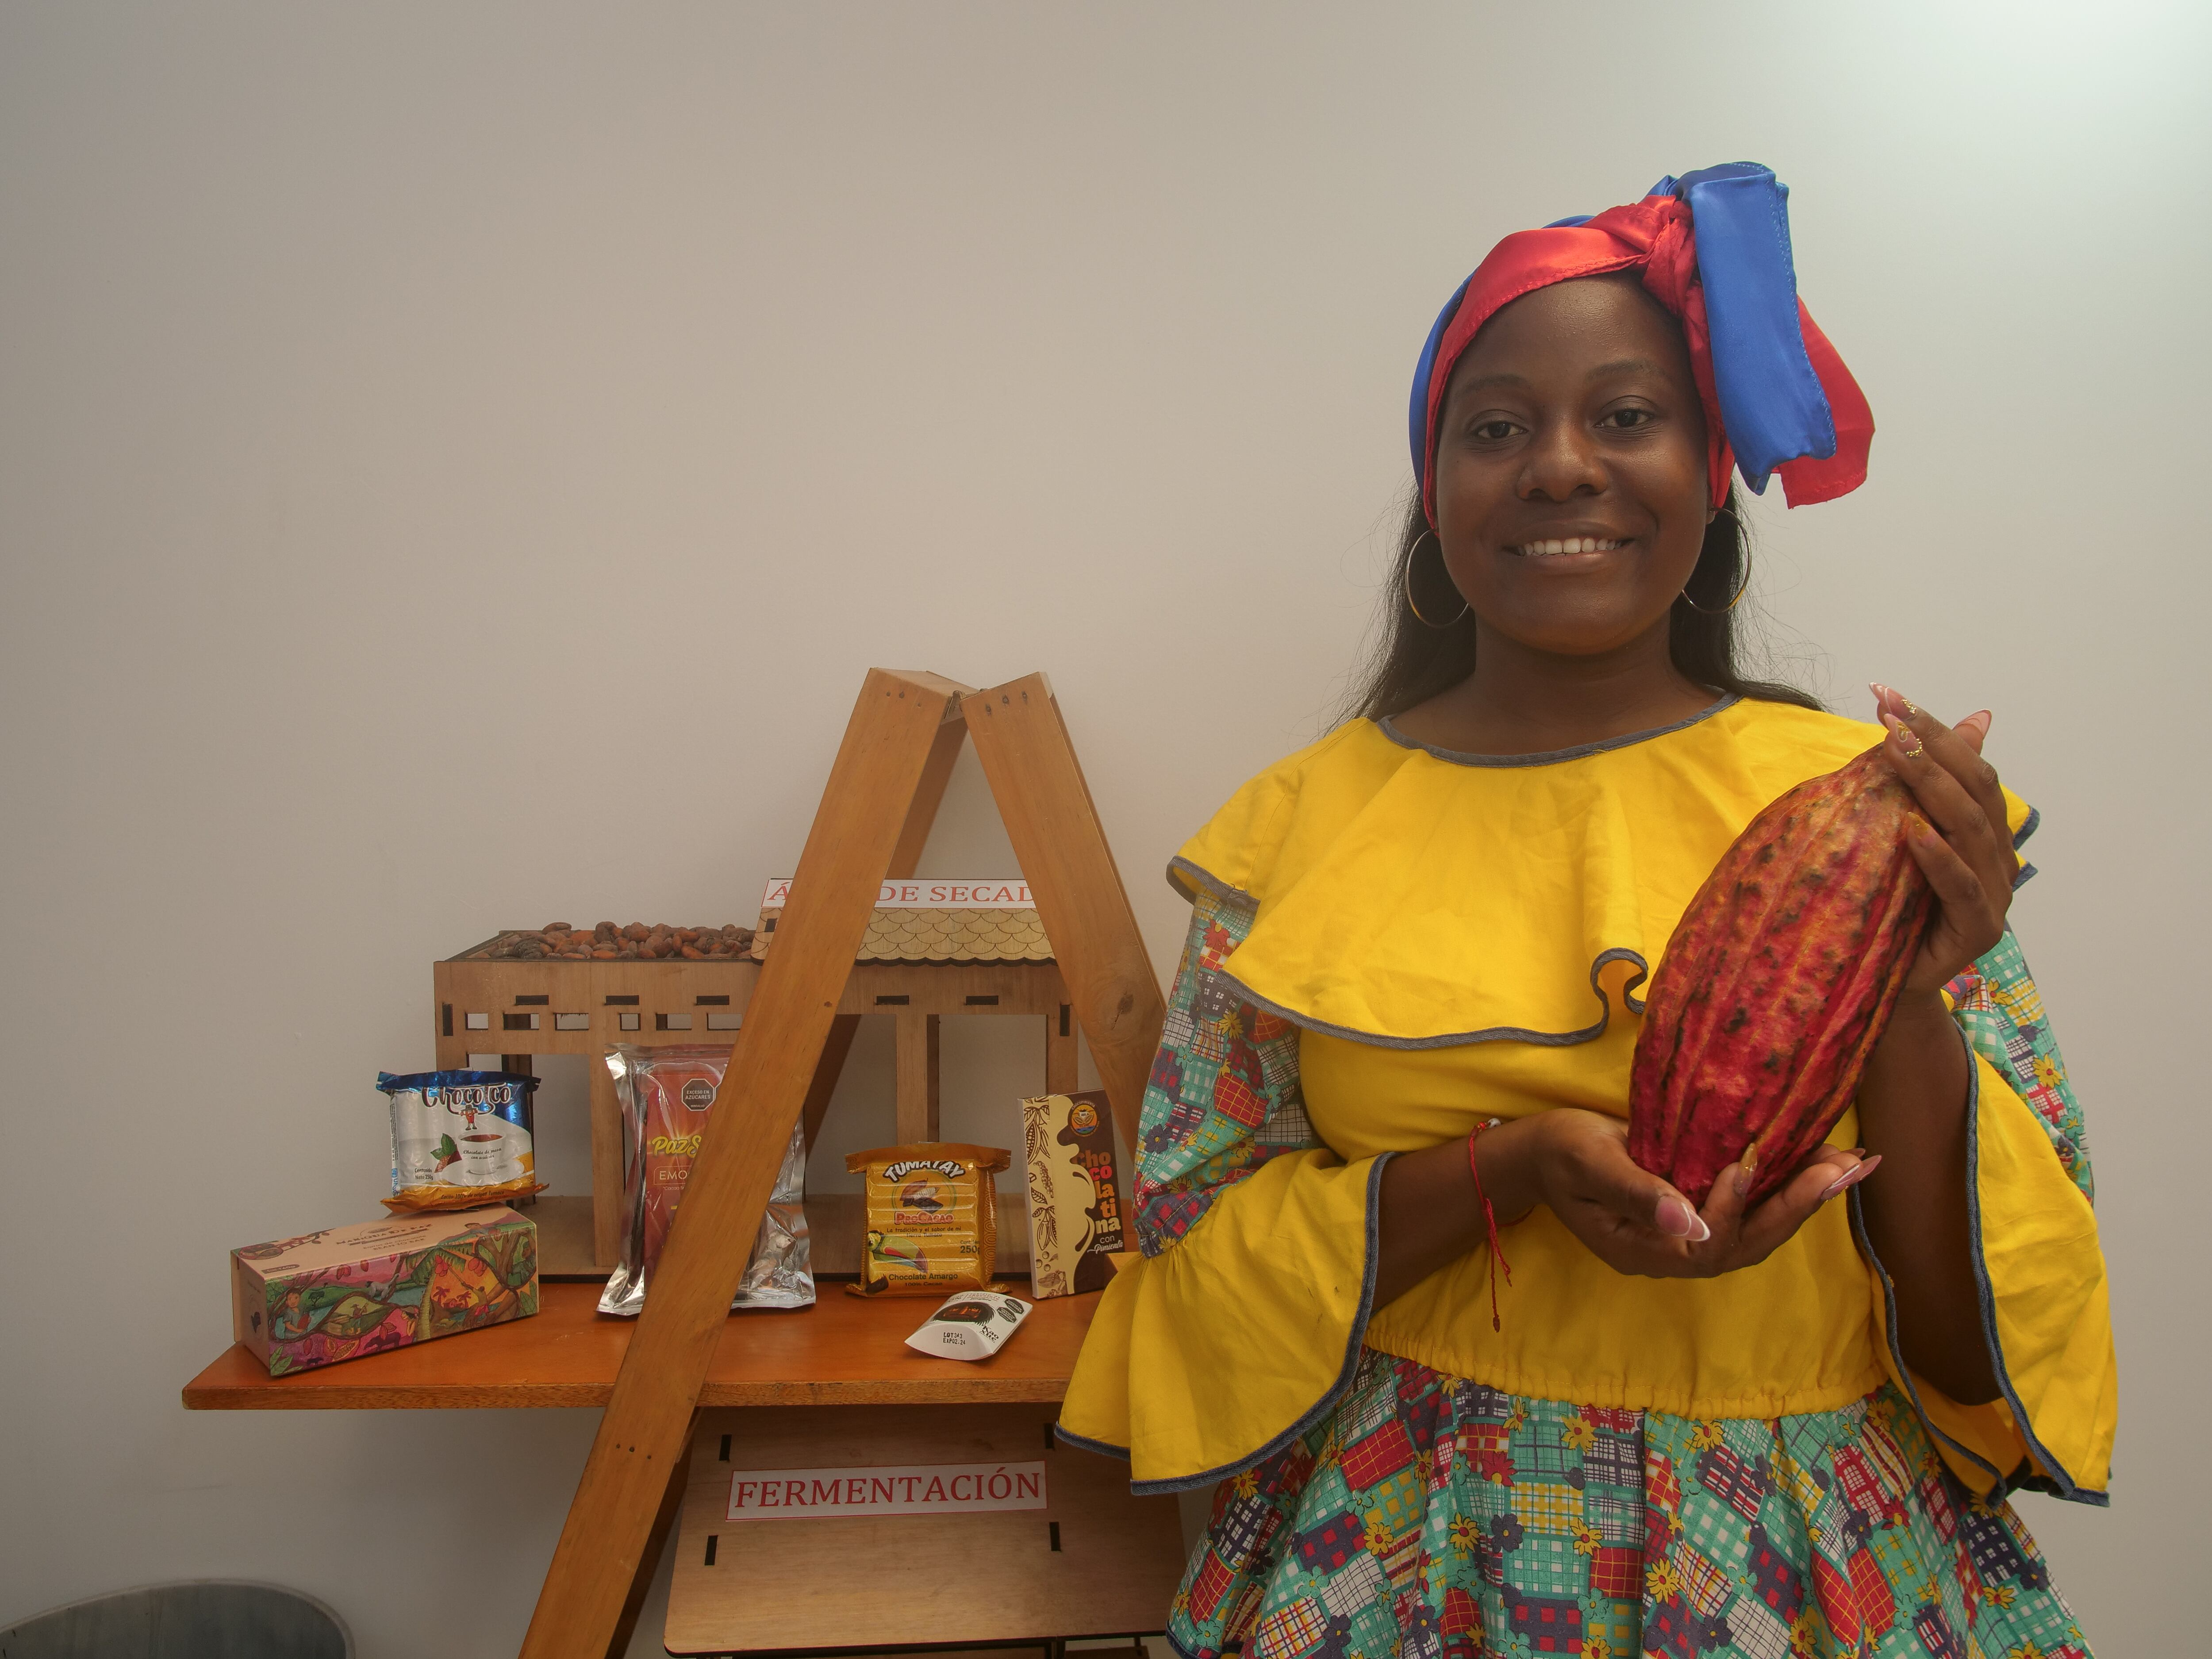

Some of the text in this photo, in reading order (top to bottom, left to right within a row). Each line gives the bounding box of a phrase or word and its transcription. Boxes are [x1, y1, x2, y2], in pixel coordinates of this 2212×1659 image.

[876, 886, 919, 901] DE
[660, 1170, 690, 1180] EMO
[1088, 1165, 1112, 1181] co
[1094, 1180, 1114, 1199] la
[1100, 1198, 1116, 1217] ti
[1095, 1217, 1121, 1234] na
[1087, 1240, 1123, 1254] Pimienta
[1100, 1235, 1115, 1244] con
[735, 1466, 1040, 1508] FERMENTACIÓN
